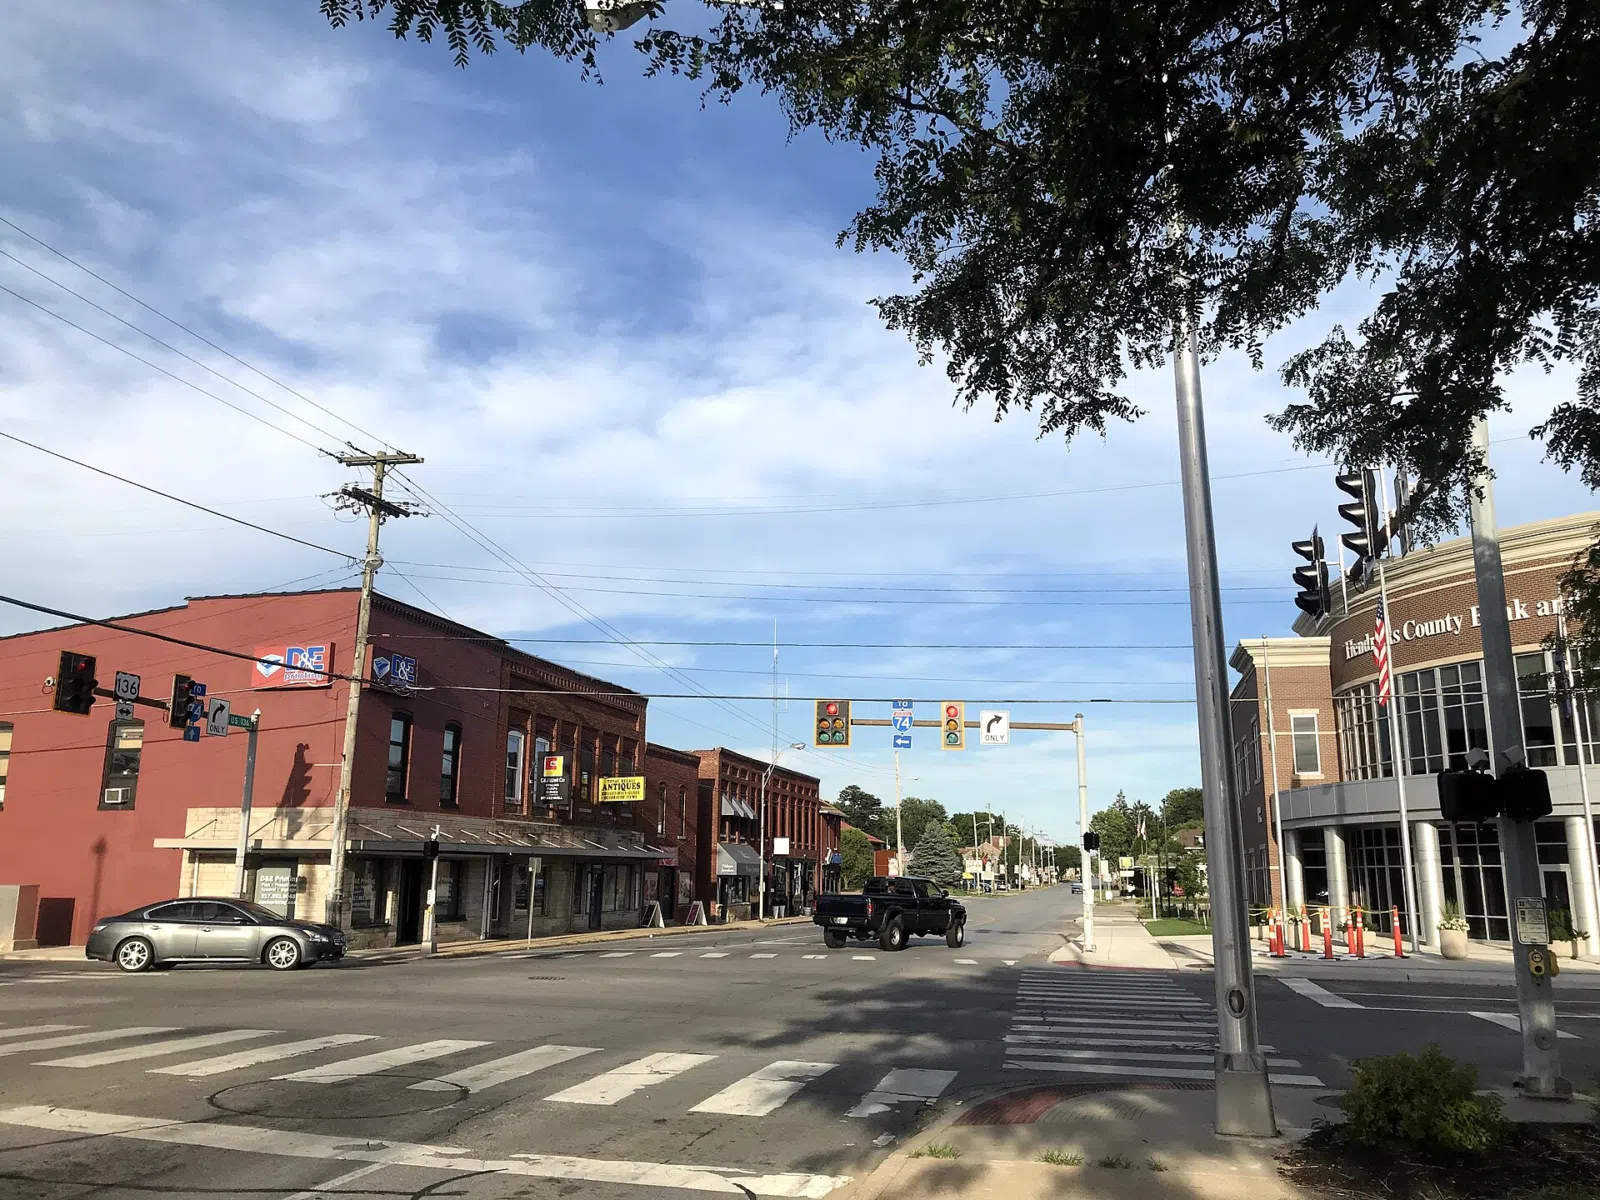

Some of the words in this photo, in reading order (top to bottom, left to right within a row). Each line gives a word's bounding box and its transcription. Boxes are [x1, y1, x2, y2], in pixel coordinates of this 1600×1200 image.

[1345, 629, 1401, 660] Hendrs
[1402, 613, 1464, 641] County
[1470, 598, 1531, 628] Bk
[285, 645, 325, 672] D&E
[391, 653, 416, 682] D&E
[116, 678, 138, 696] 136
[209, 725, 226, 734] ONLY
[240, 719, 250, 727] 136
[894, 717, 910, 729] 74
[602, 782, 641, 791] ANTIQUES
